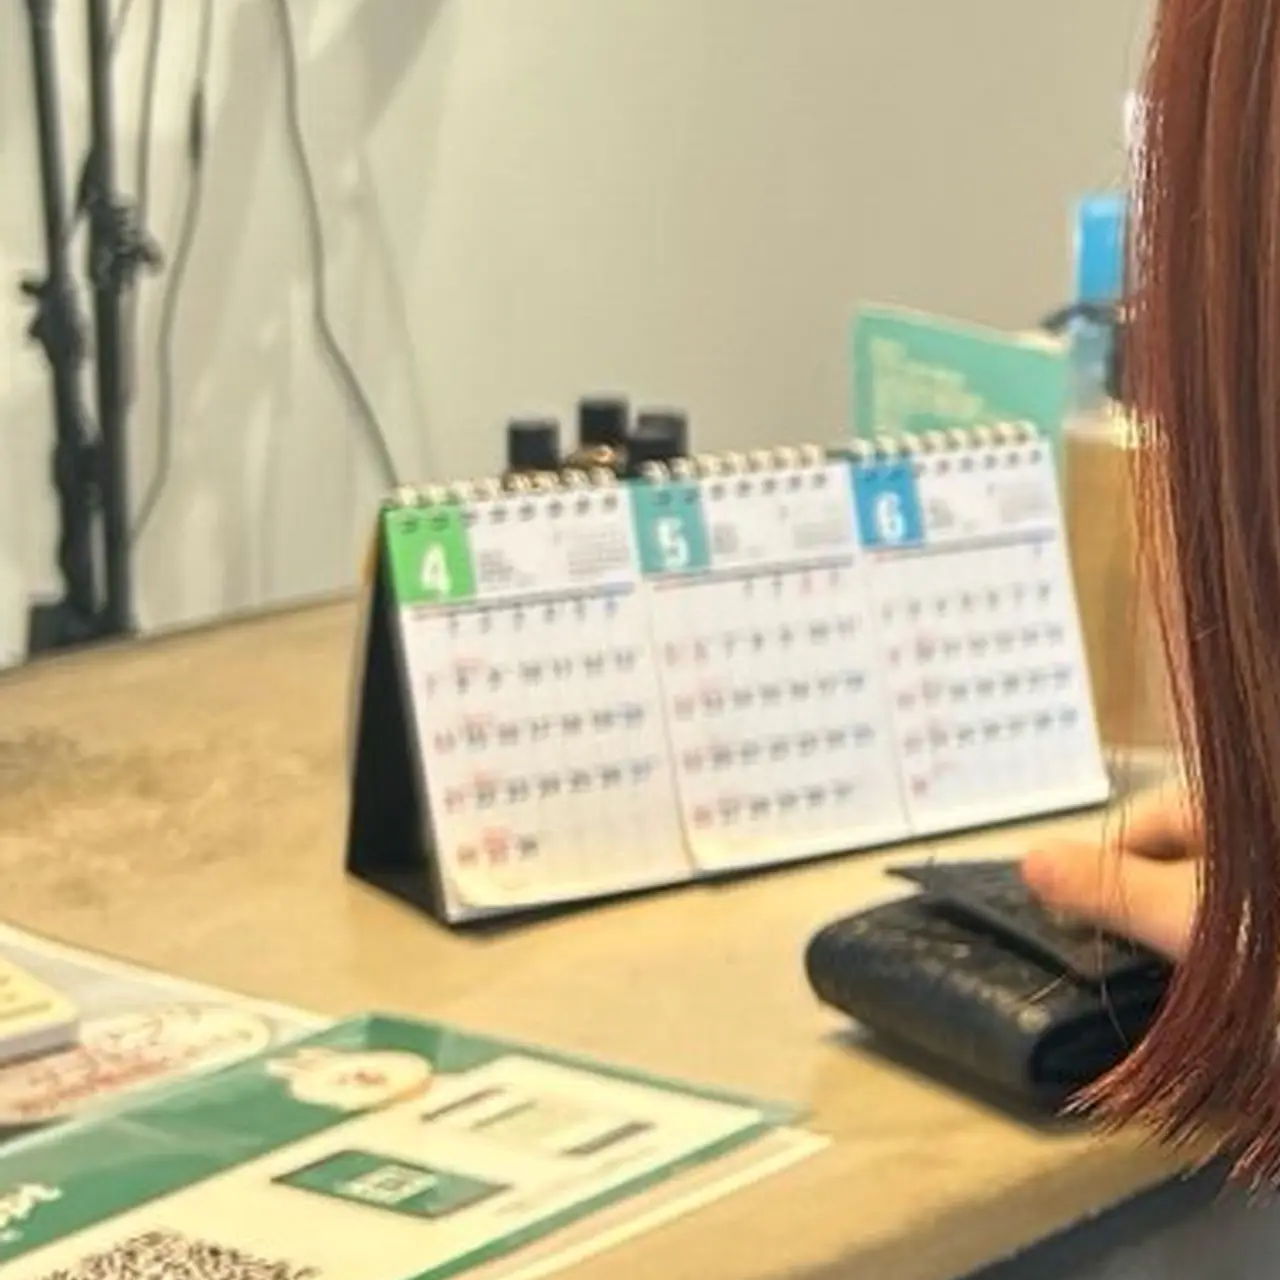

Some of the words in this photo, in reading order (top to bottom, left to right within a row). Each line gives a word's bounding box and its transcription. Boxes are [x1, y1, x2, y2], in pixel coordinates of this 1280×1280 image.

[656, 516, 691, 569] 5
[873, 491, 908, 543] 6
[419, 543, 453, 599] 4
